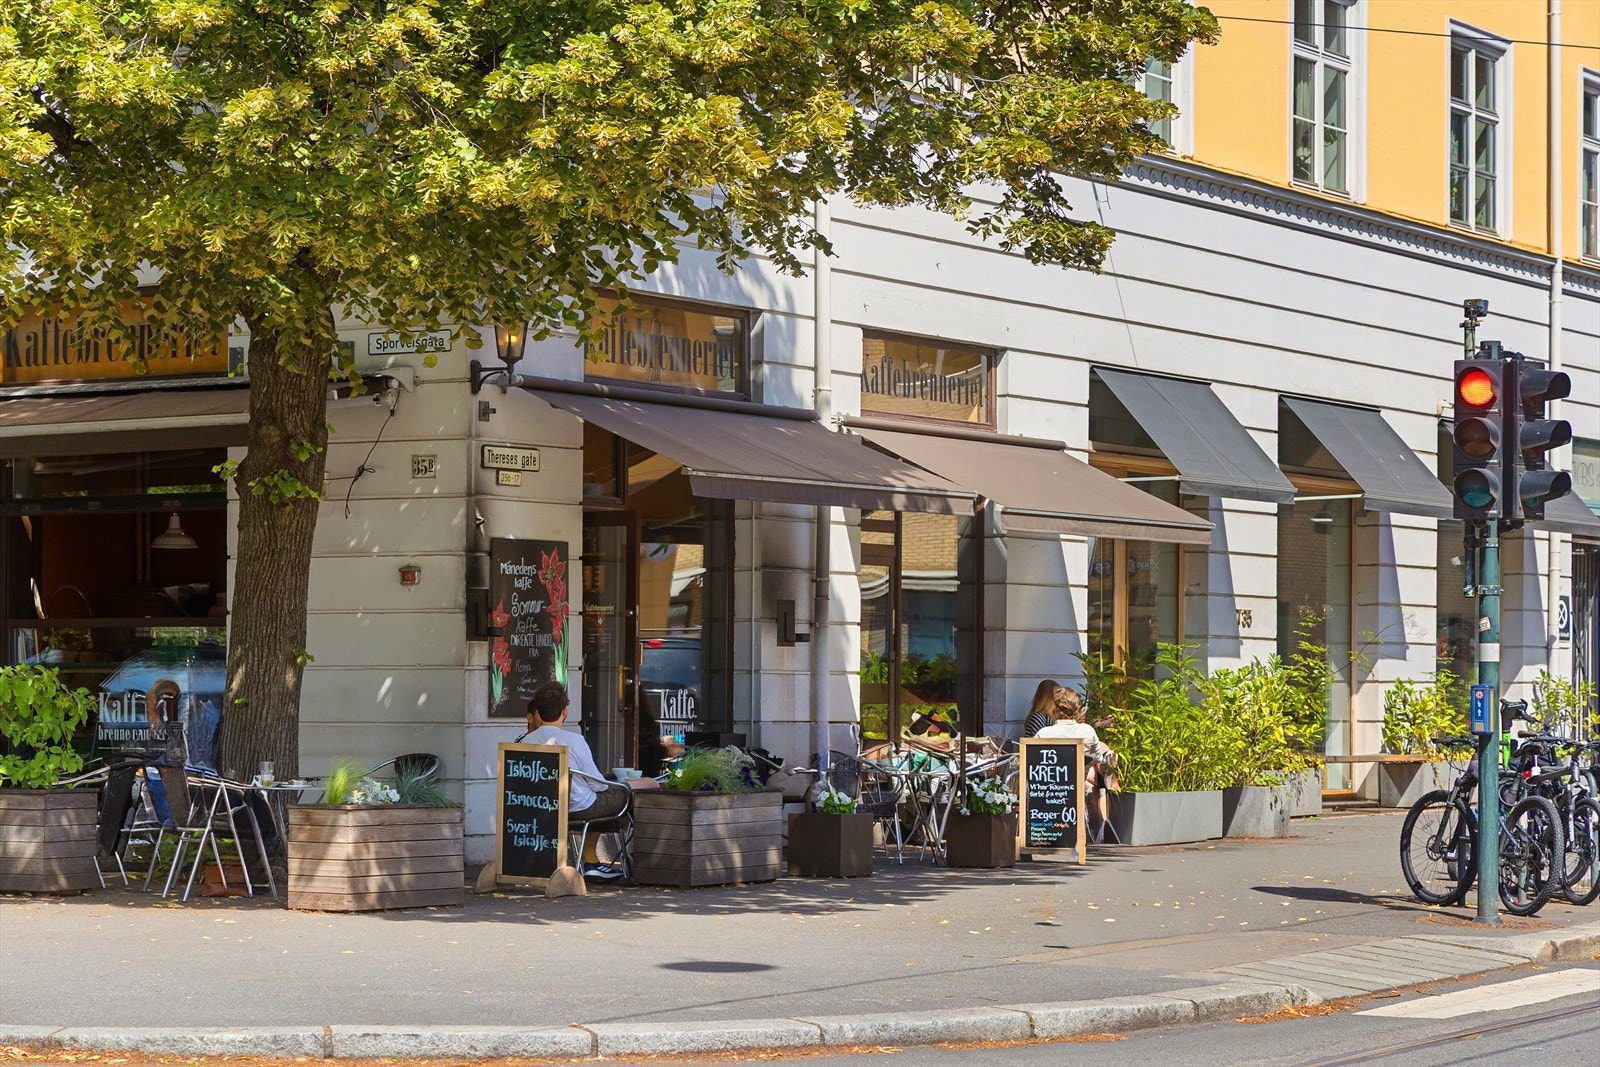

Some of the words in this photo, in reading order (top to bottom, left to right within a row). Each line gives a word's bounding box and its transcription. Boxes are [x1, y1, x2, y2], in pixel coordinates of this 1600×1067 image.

[861, 353, 984, 407] Kaffebrenneriet
[413, 458, 434, 475] 35B
[487, 449, 519, 465] Thereses
[521, 453, 537, 468] gate
[515, 617, 540, 634] kaffe
[98, 692, 149, 723] Kaff
[1040, 749, 1058, 764] IS
[506, 759, 548, 783] Iskaffe
[1029, 764, 1068, 783] KREM
[507, 818, 538, 835] Svart
[513, 833, 549, 852] Iskaffe
